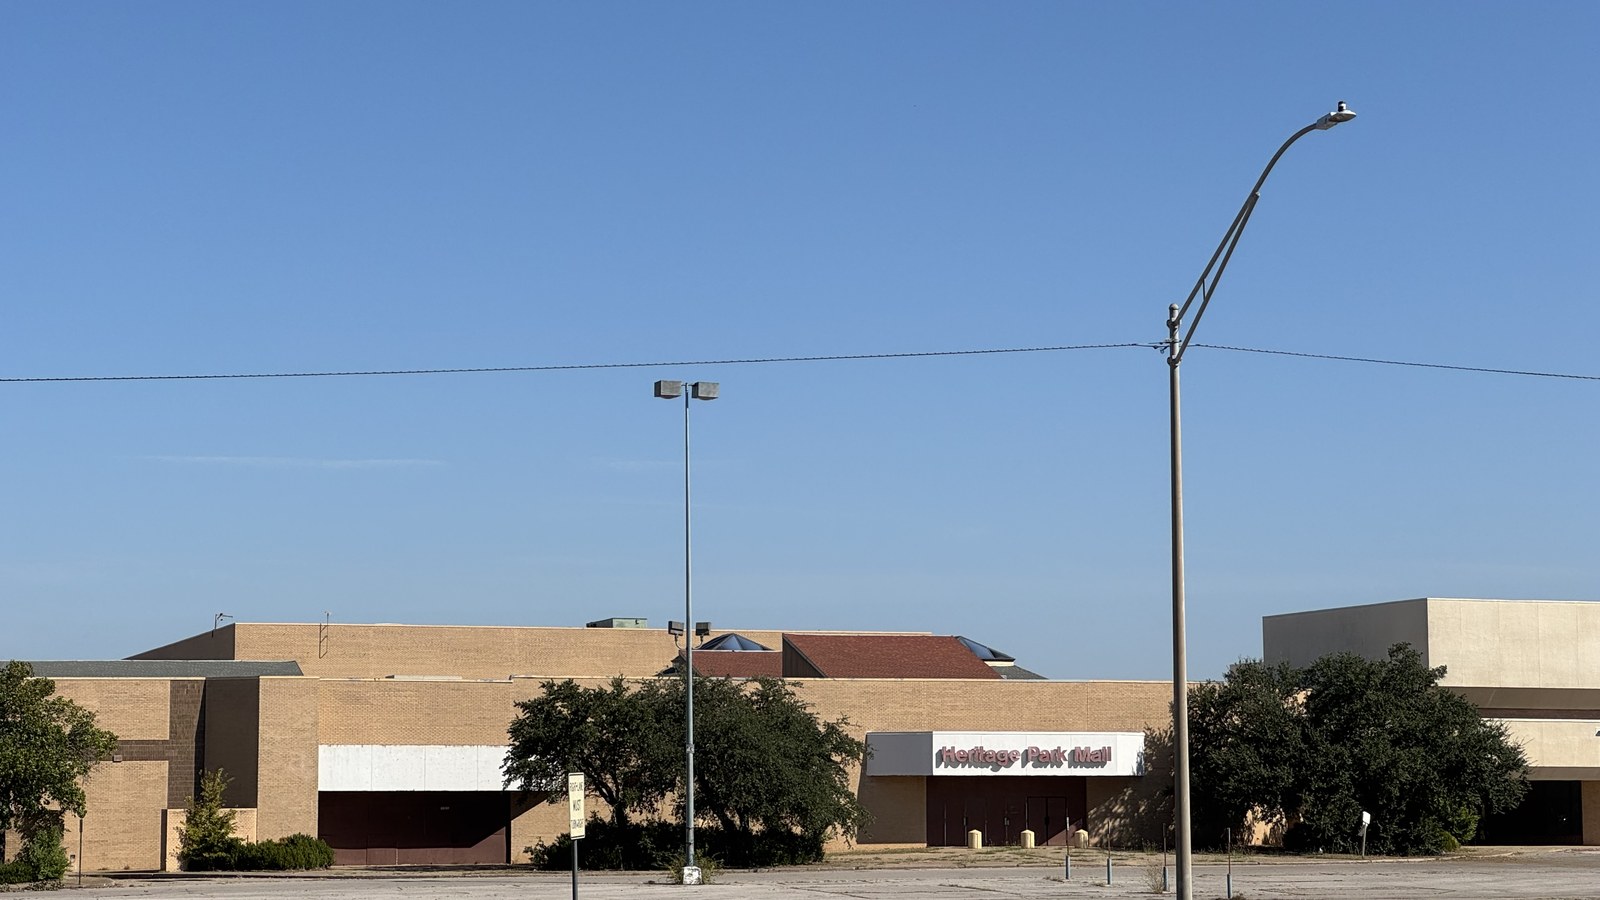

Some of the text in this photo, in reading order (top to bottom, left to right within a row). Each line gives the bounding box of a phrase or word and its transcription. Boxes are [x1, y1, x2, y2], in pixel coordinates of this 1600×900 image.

[941, 746, 1112, 765] Heritage Park Mall
